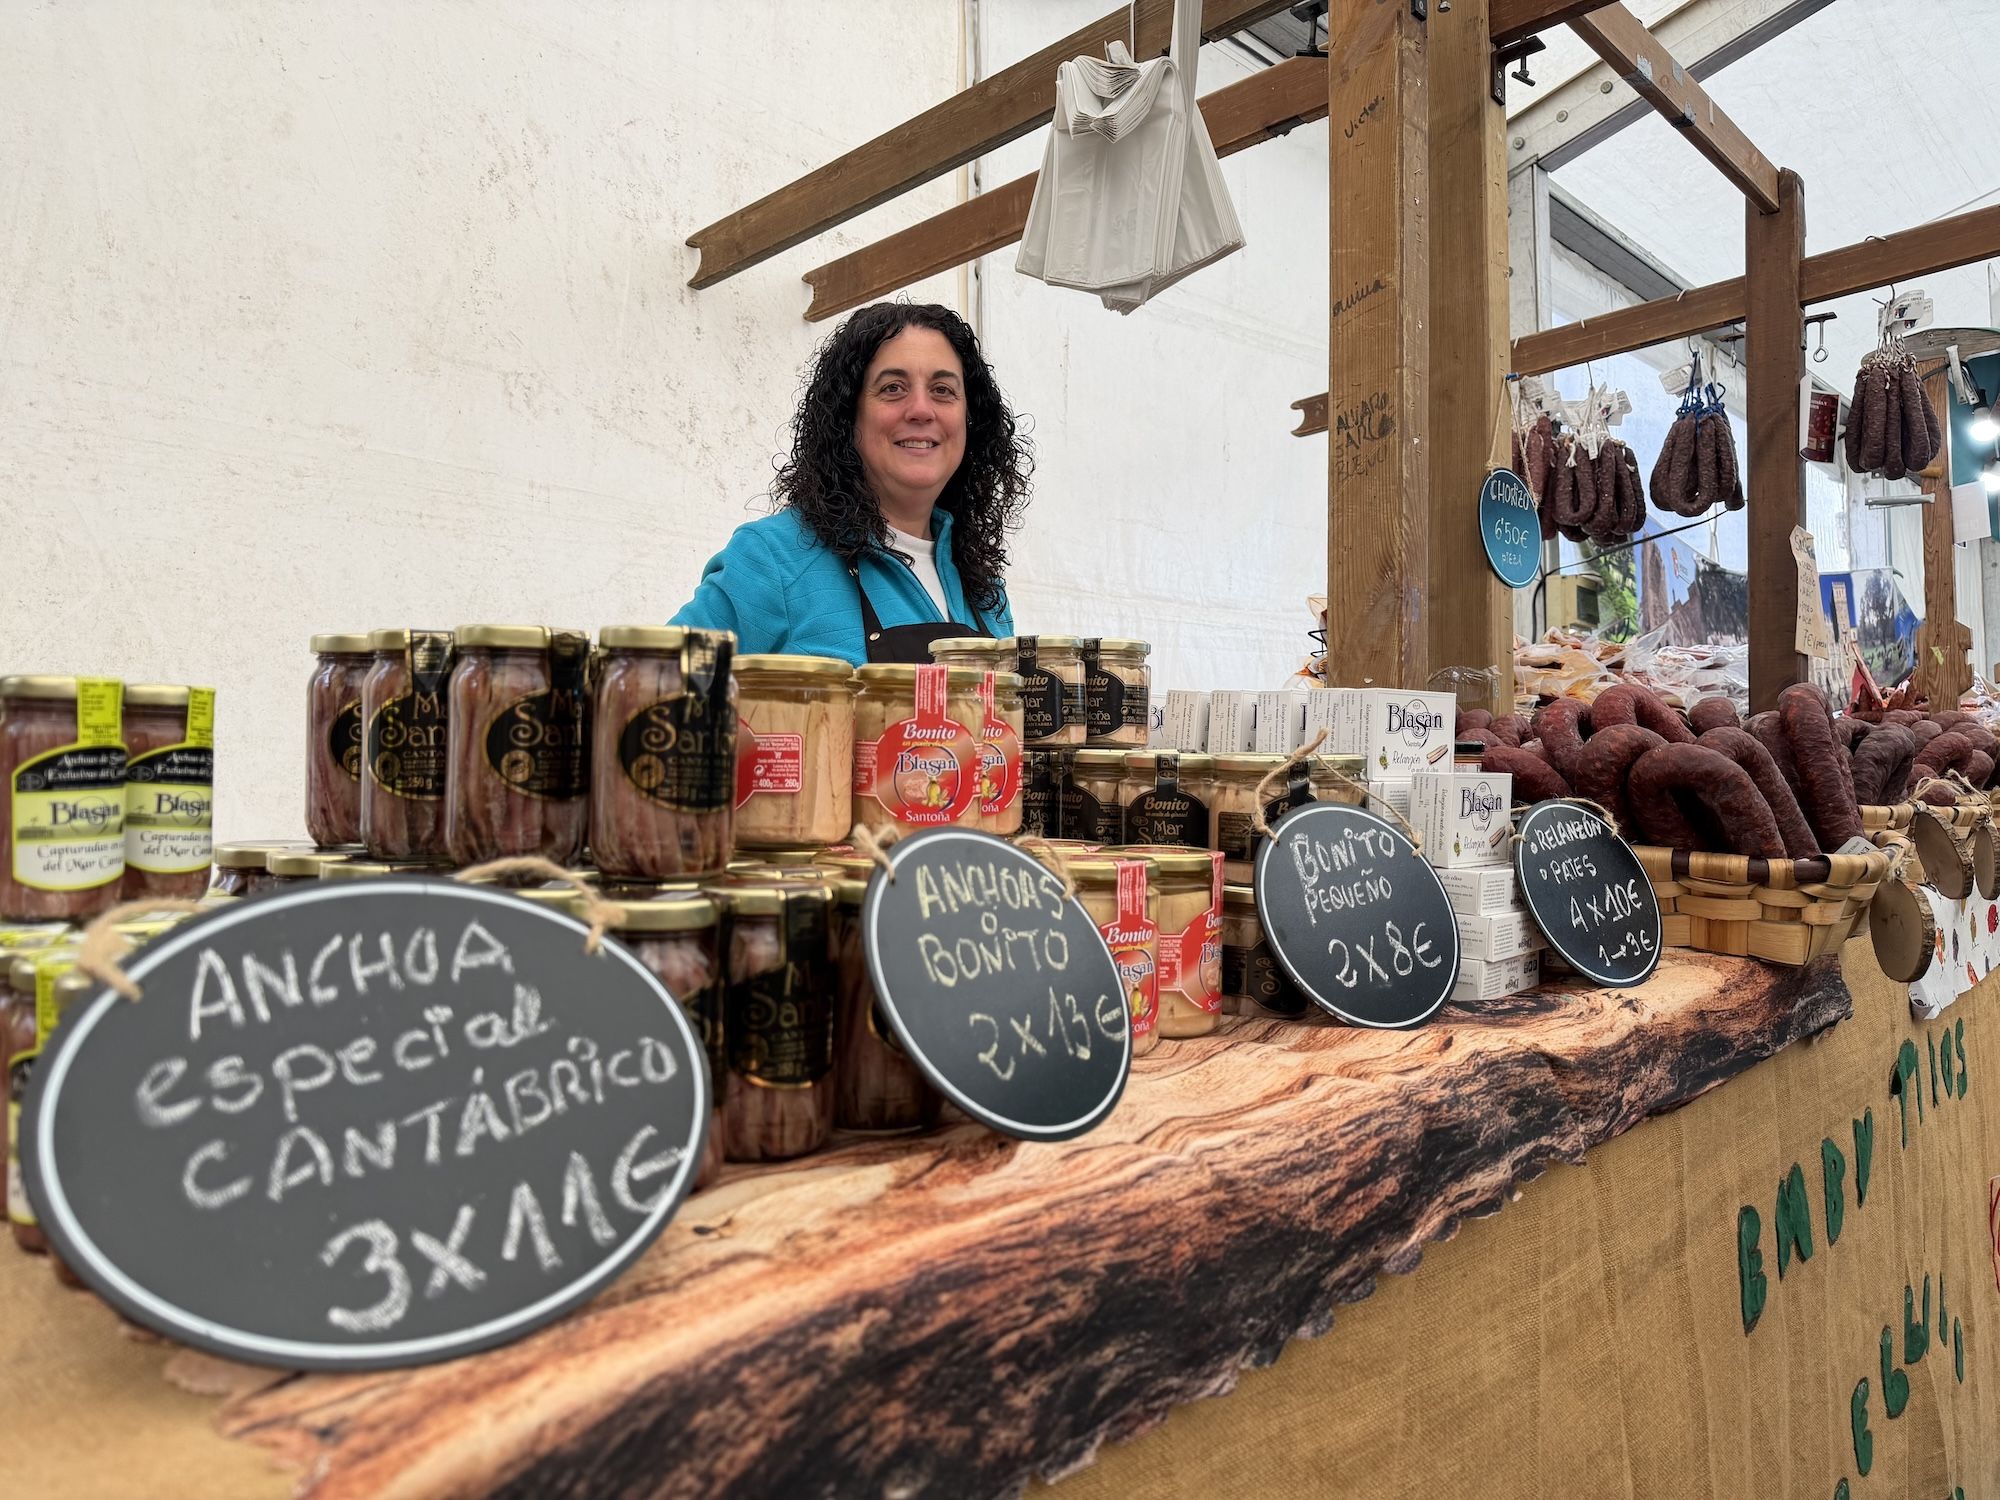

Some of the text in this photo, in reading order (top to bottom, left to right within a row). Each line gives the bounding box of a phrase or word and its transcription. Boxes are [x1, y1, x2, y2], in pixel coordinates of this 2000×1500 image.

[1386, 703, 1444, 738] Blasan
[903, 723, 956, 740] Bonito
[897, 752, 957, 777] Blasan
[1144, 797, 1190, 811] Bonito
[1459, 787, 1503, 822] Blasan
[905, 810, 951, 823] Santoña
[1153, 820, 1183, 835] Mar
[915, 861, 1064, 920] ANCHOAS
[1106, 927, 1152, 945] Bonito
[190, 920, 514, 1041] ANCHOA
